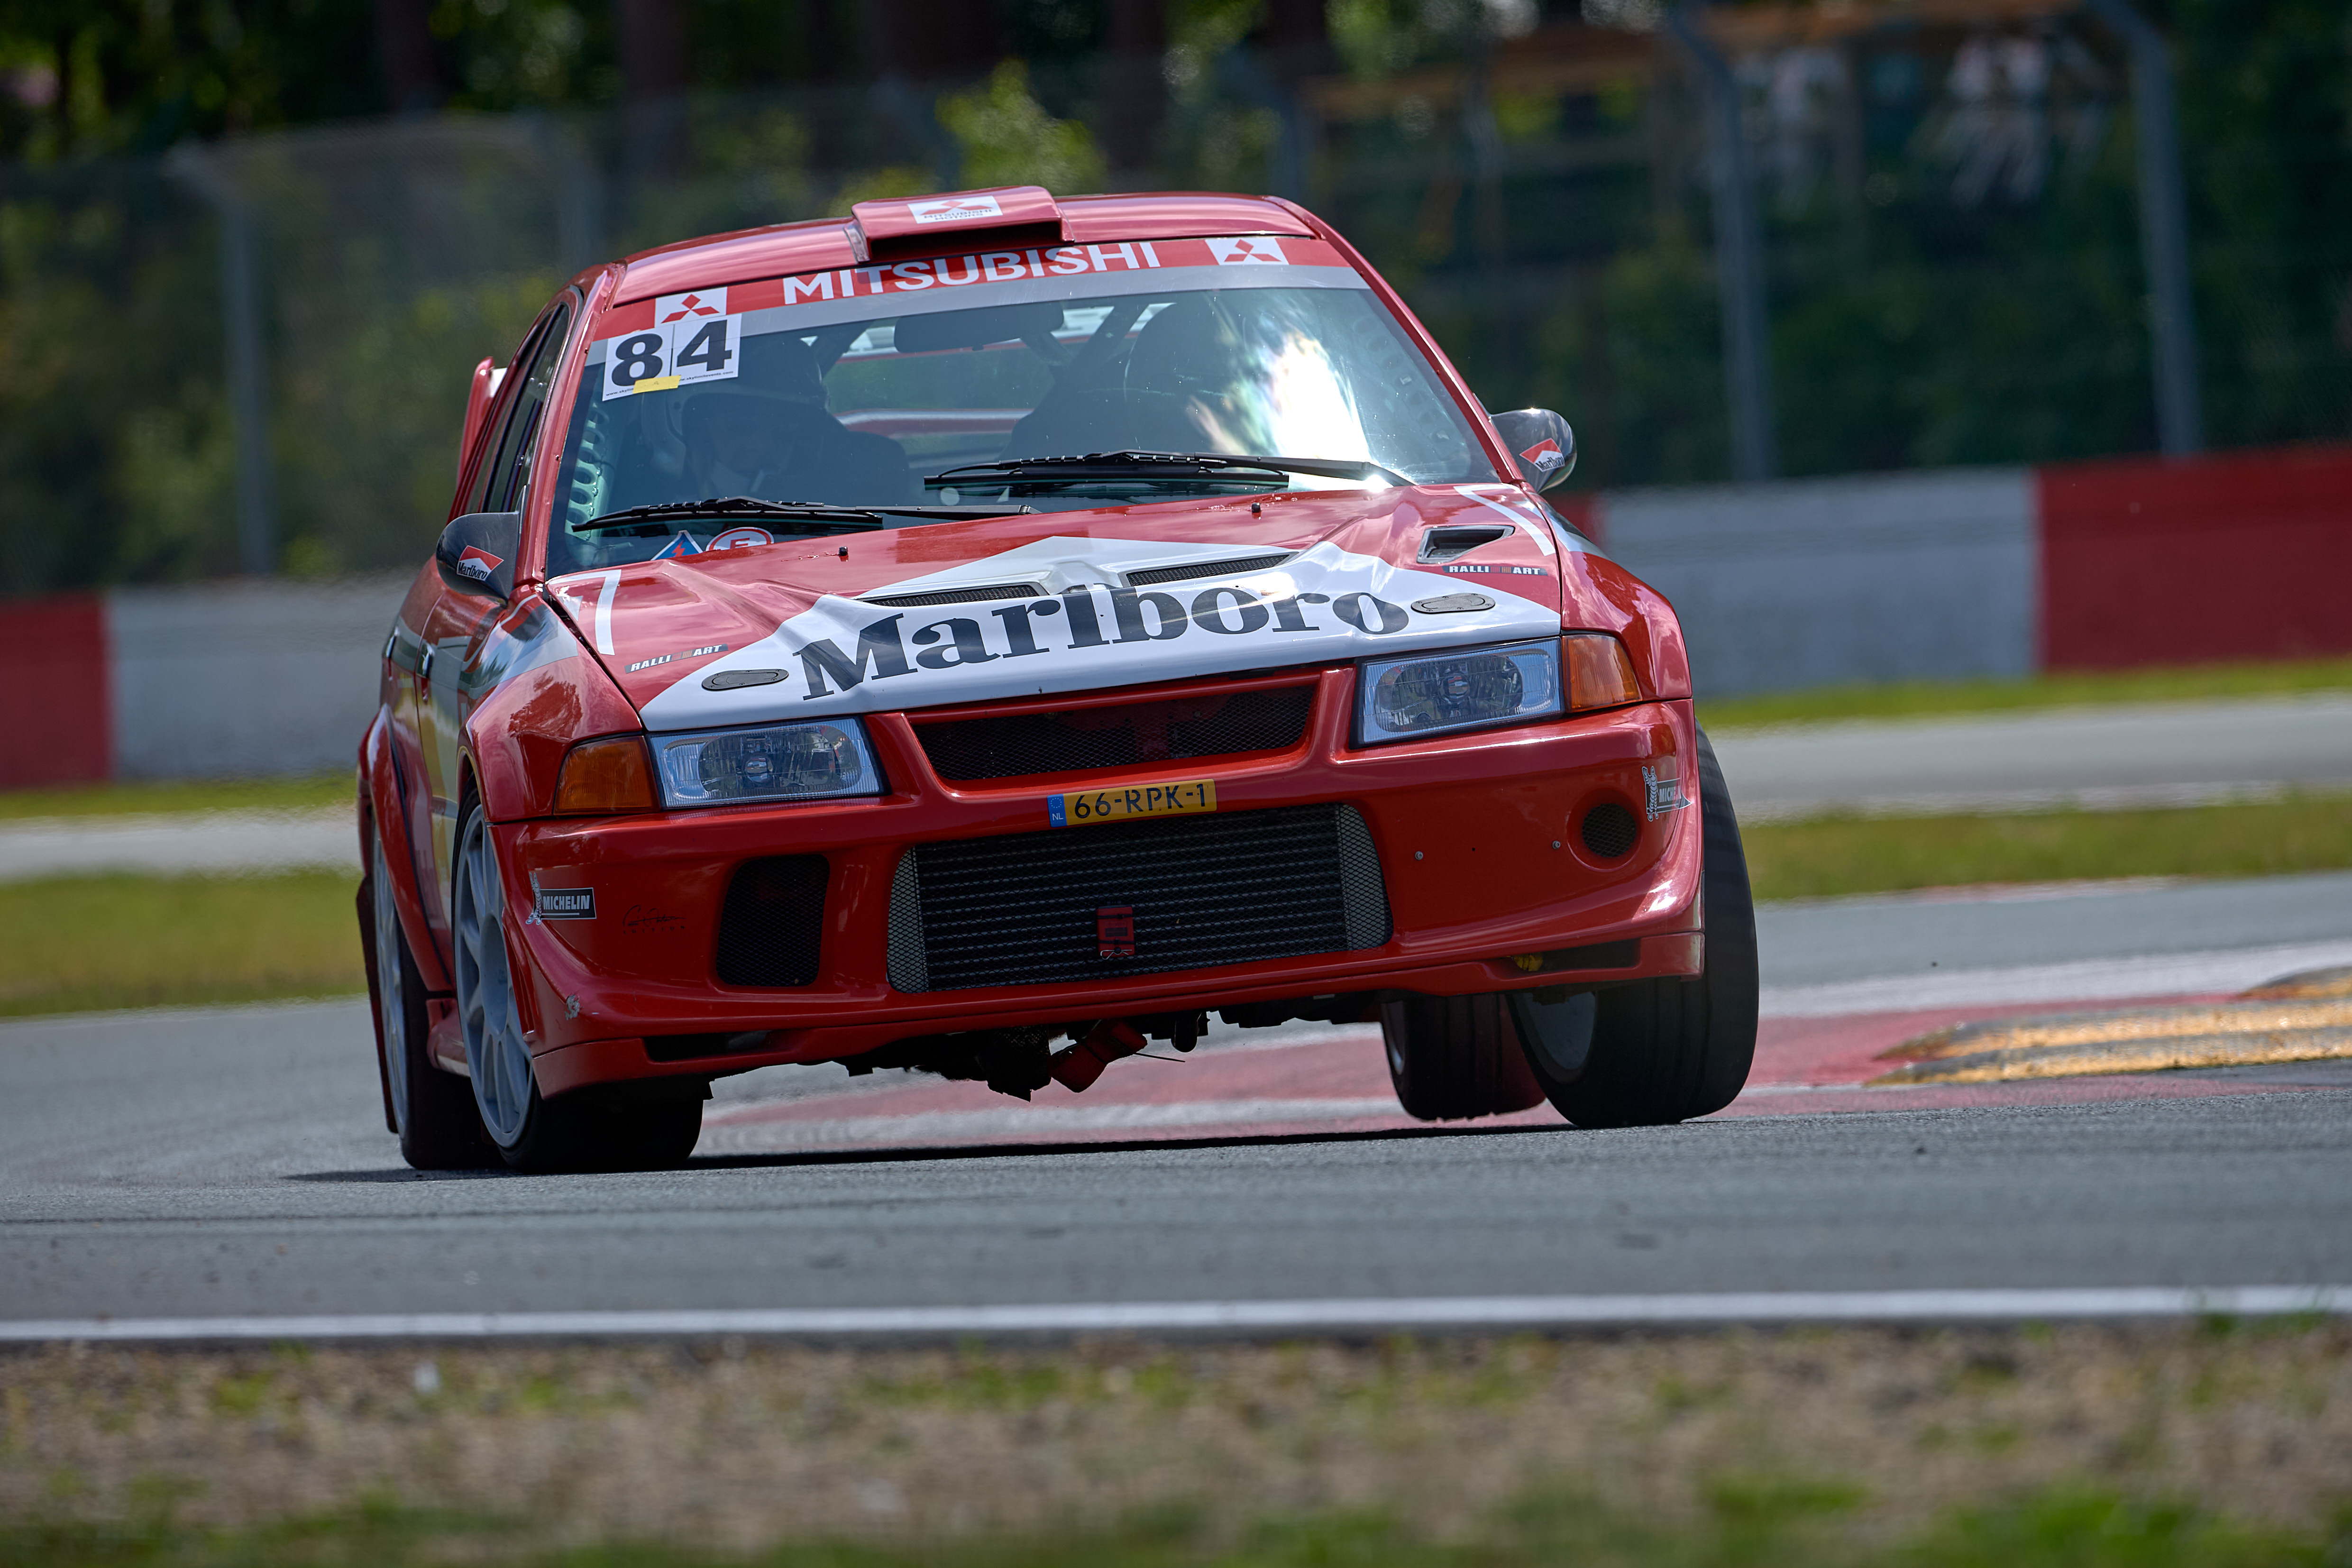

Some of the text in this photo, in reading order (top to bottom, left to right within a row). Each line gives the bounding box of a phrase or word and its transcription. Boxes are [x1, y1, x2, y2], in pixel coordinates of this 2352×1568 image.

[924, 209, 992, 219] MITSUBISHI
[783, 241, 1161, 304] MITSUBISHI
[612, 319, 732, 386] 84
[1535, 457, 1564, 471] Marlboro
[458, 561, 488, 579] Marlboro
[1512, 567, 1540, 575] ART
[792, 582, 1409, 701] Marlboro
[630, 644, 723, 672] RALLI ART
[1052, 783, 1206, 821] NL 66-RPK-1
[543, 895, 590, 910] MICHELIN
